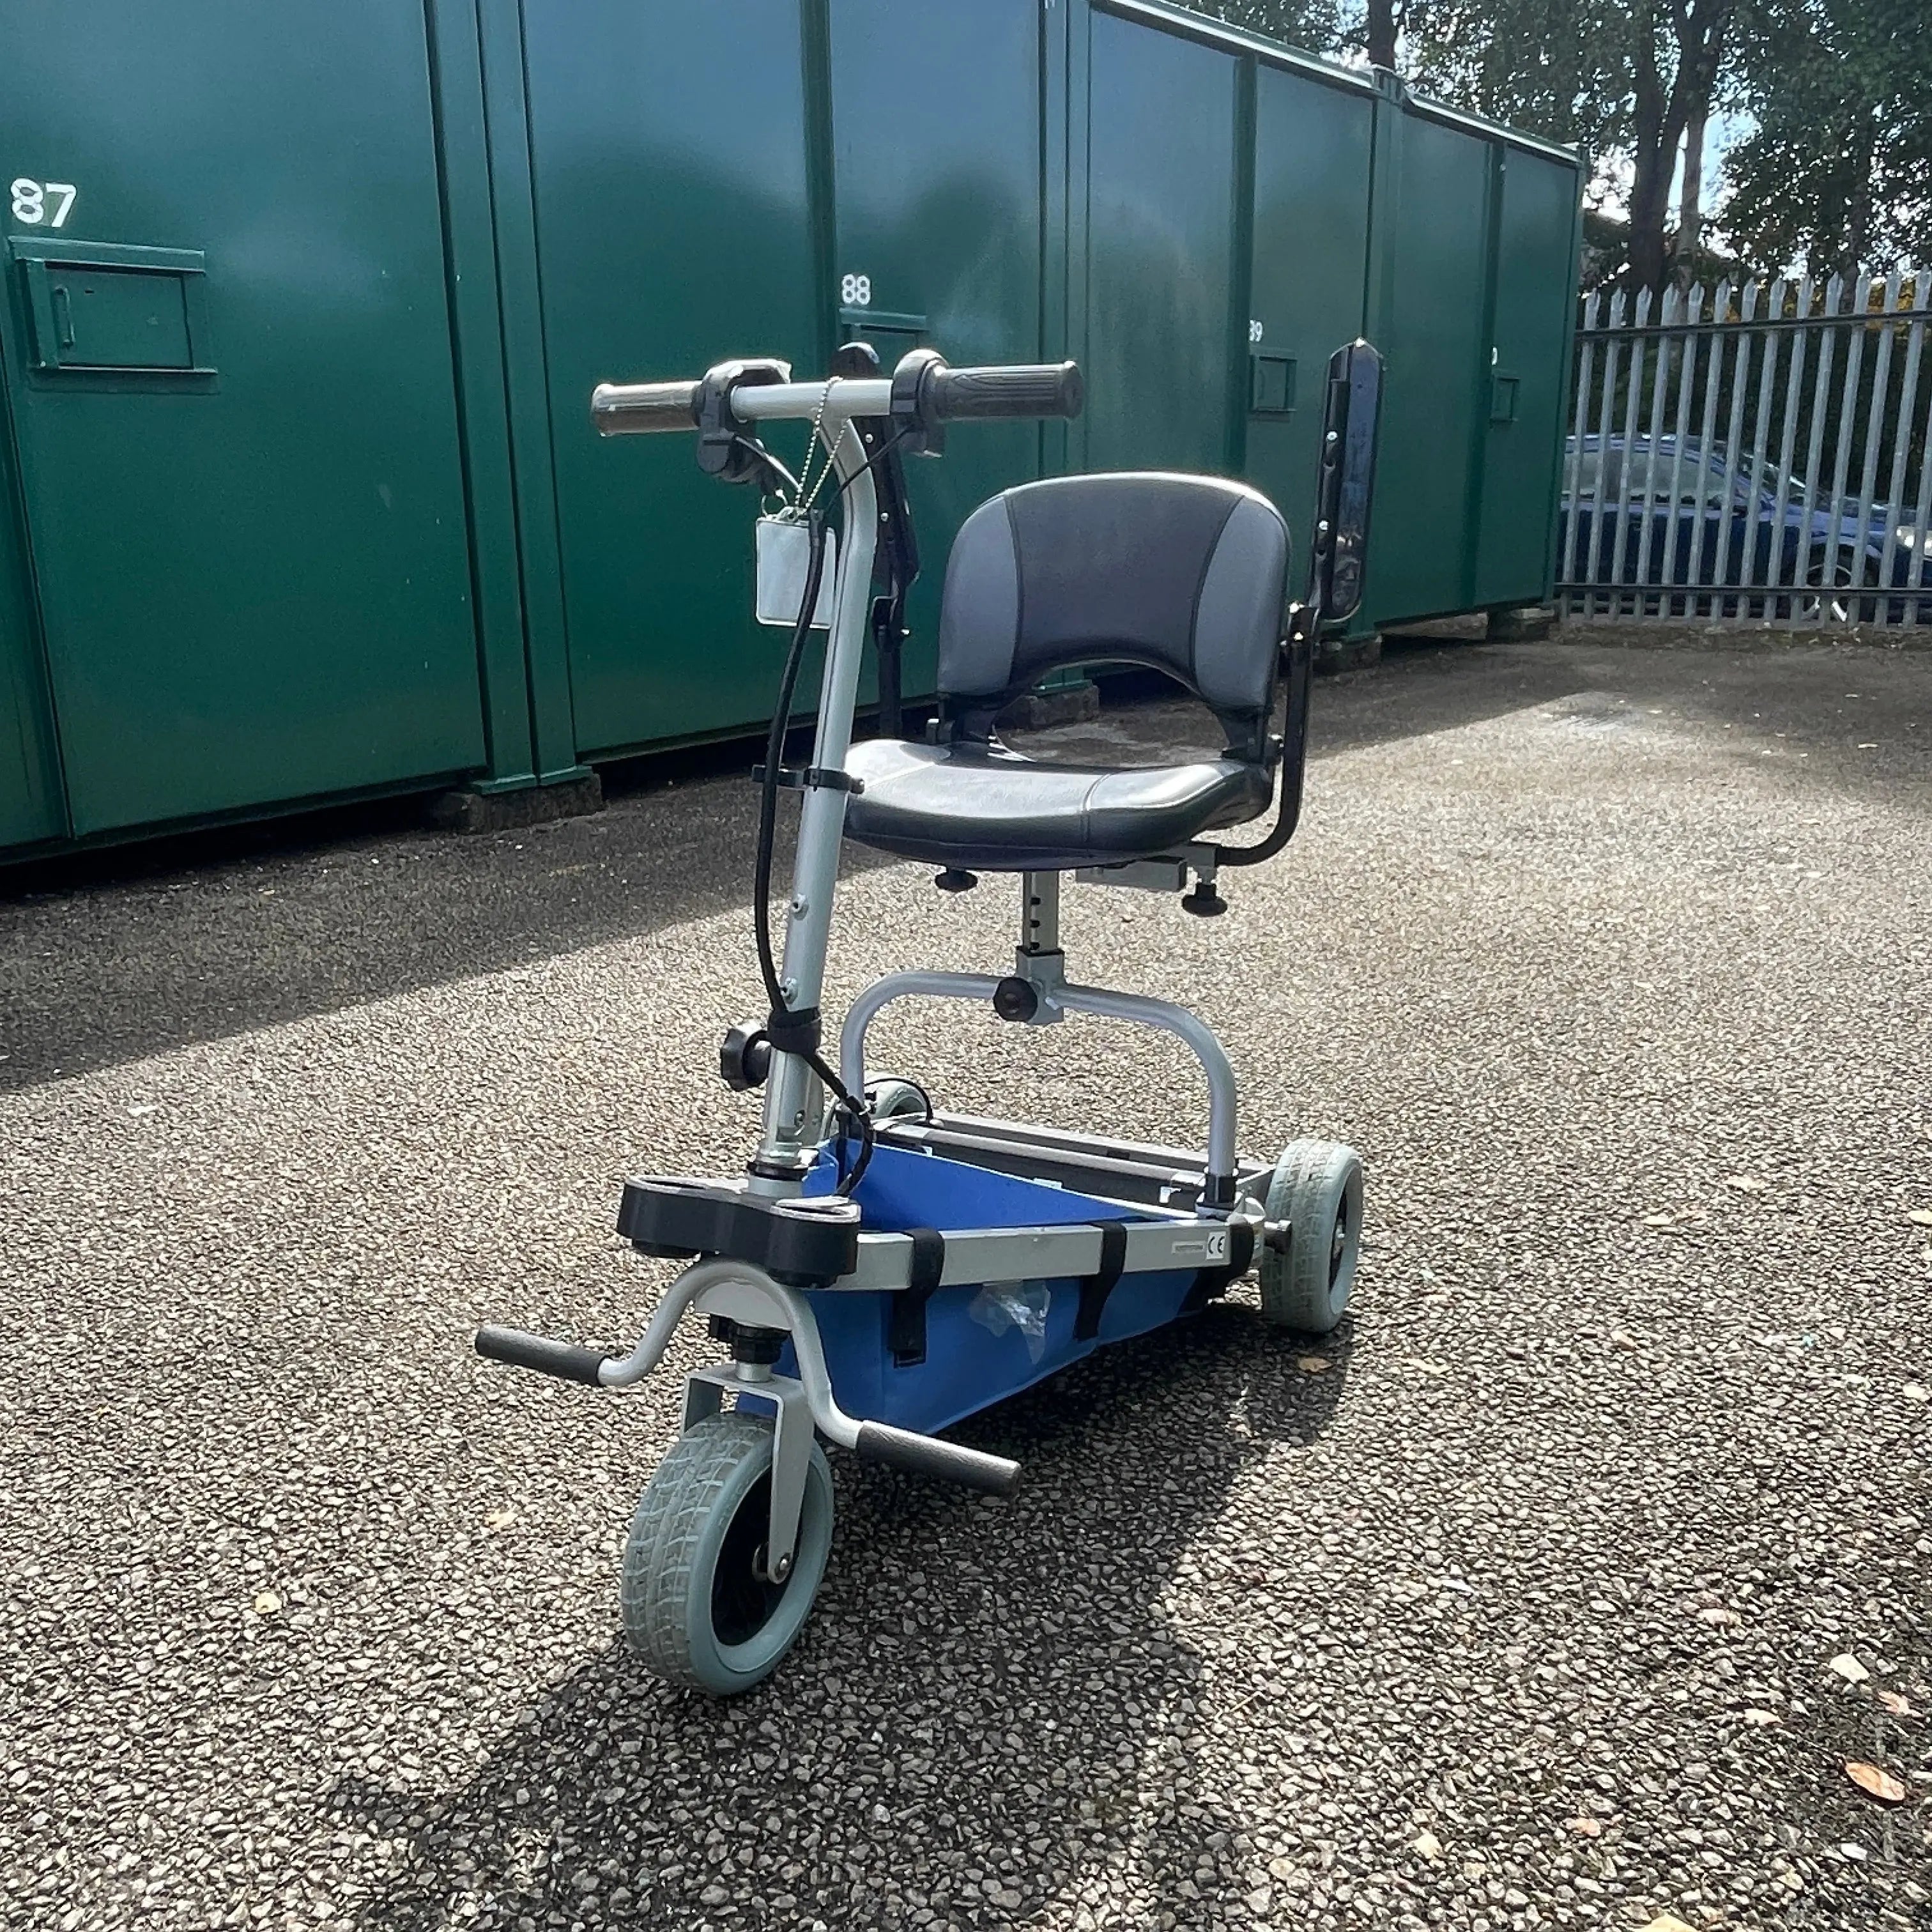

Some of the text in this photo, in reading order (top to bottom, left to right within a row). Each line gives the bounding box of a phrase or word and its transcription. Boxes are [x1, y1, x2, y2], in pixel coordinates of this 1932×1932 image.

[11, 178, 76, 227] 87
[842, 273, 871, 305] 88
[1208, 1236, 1225, 1254] CE
